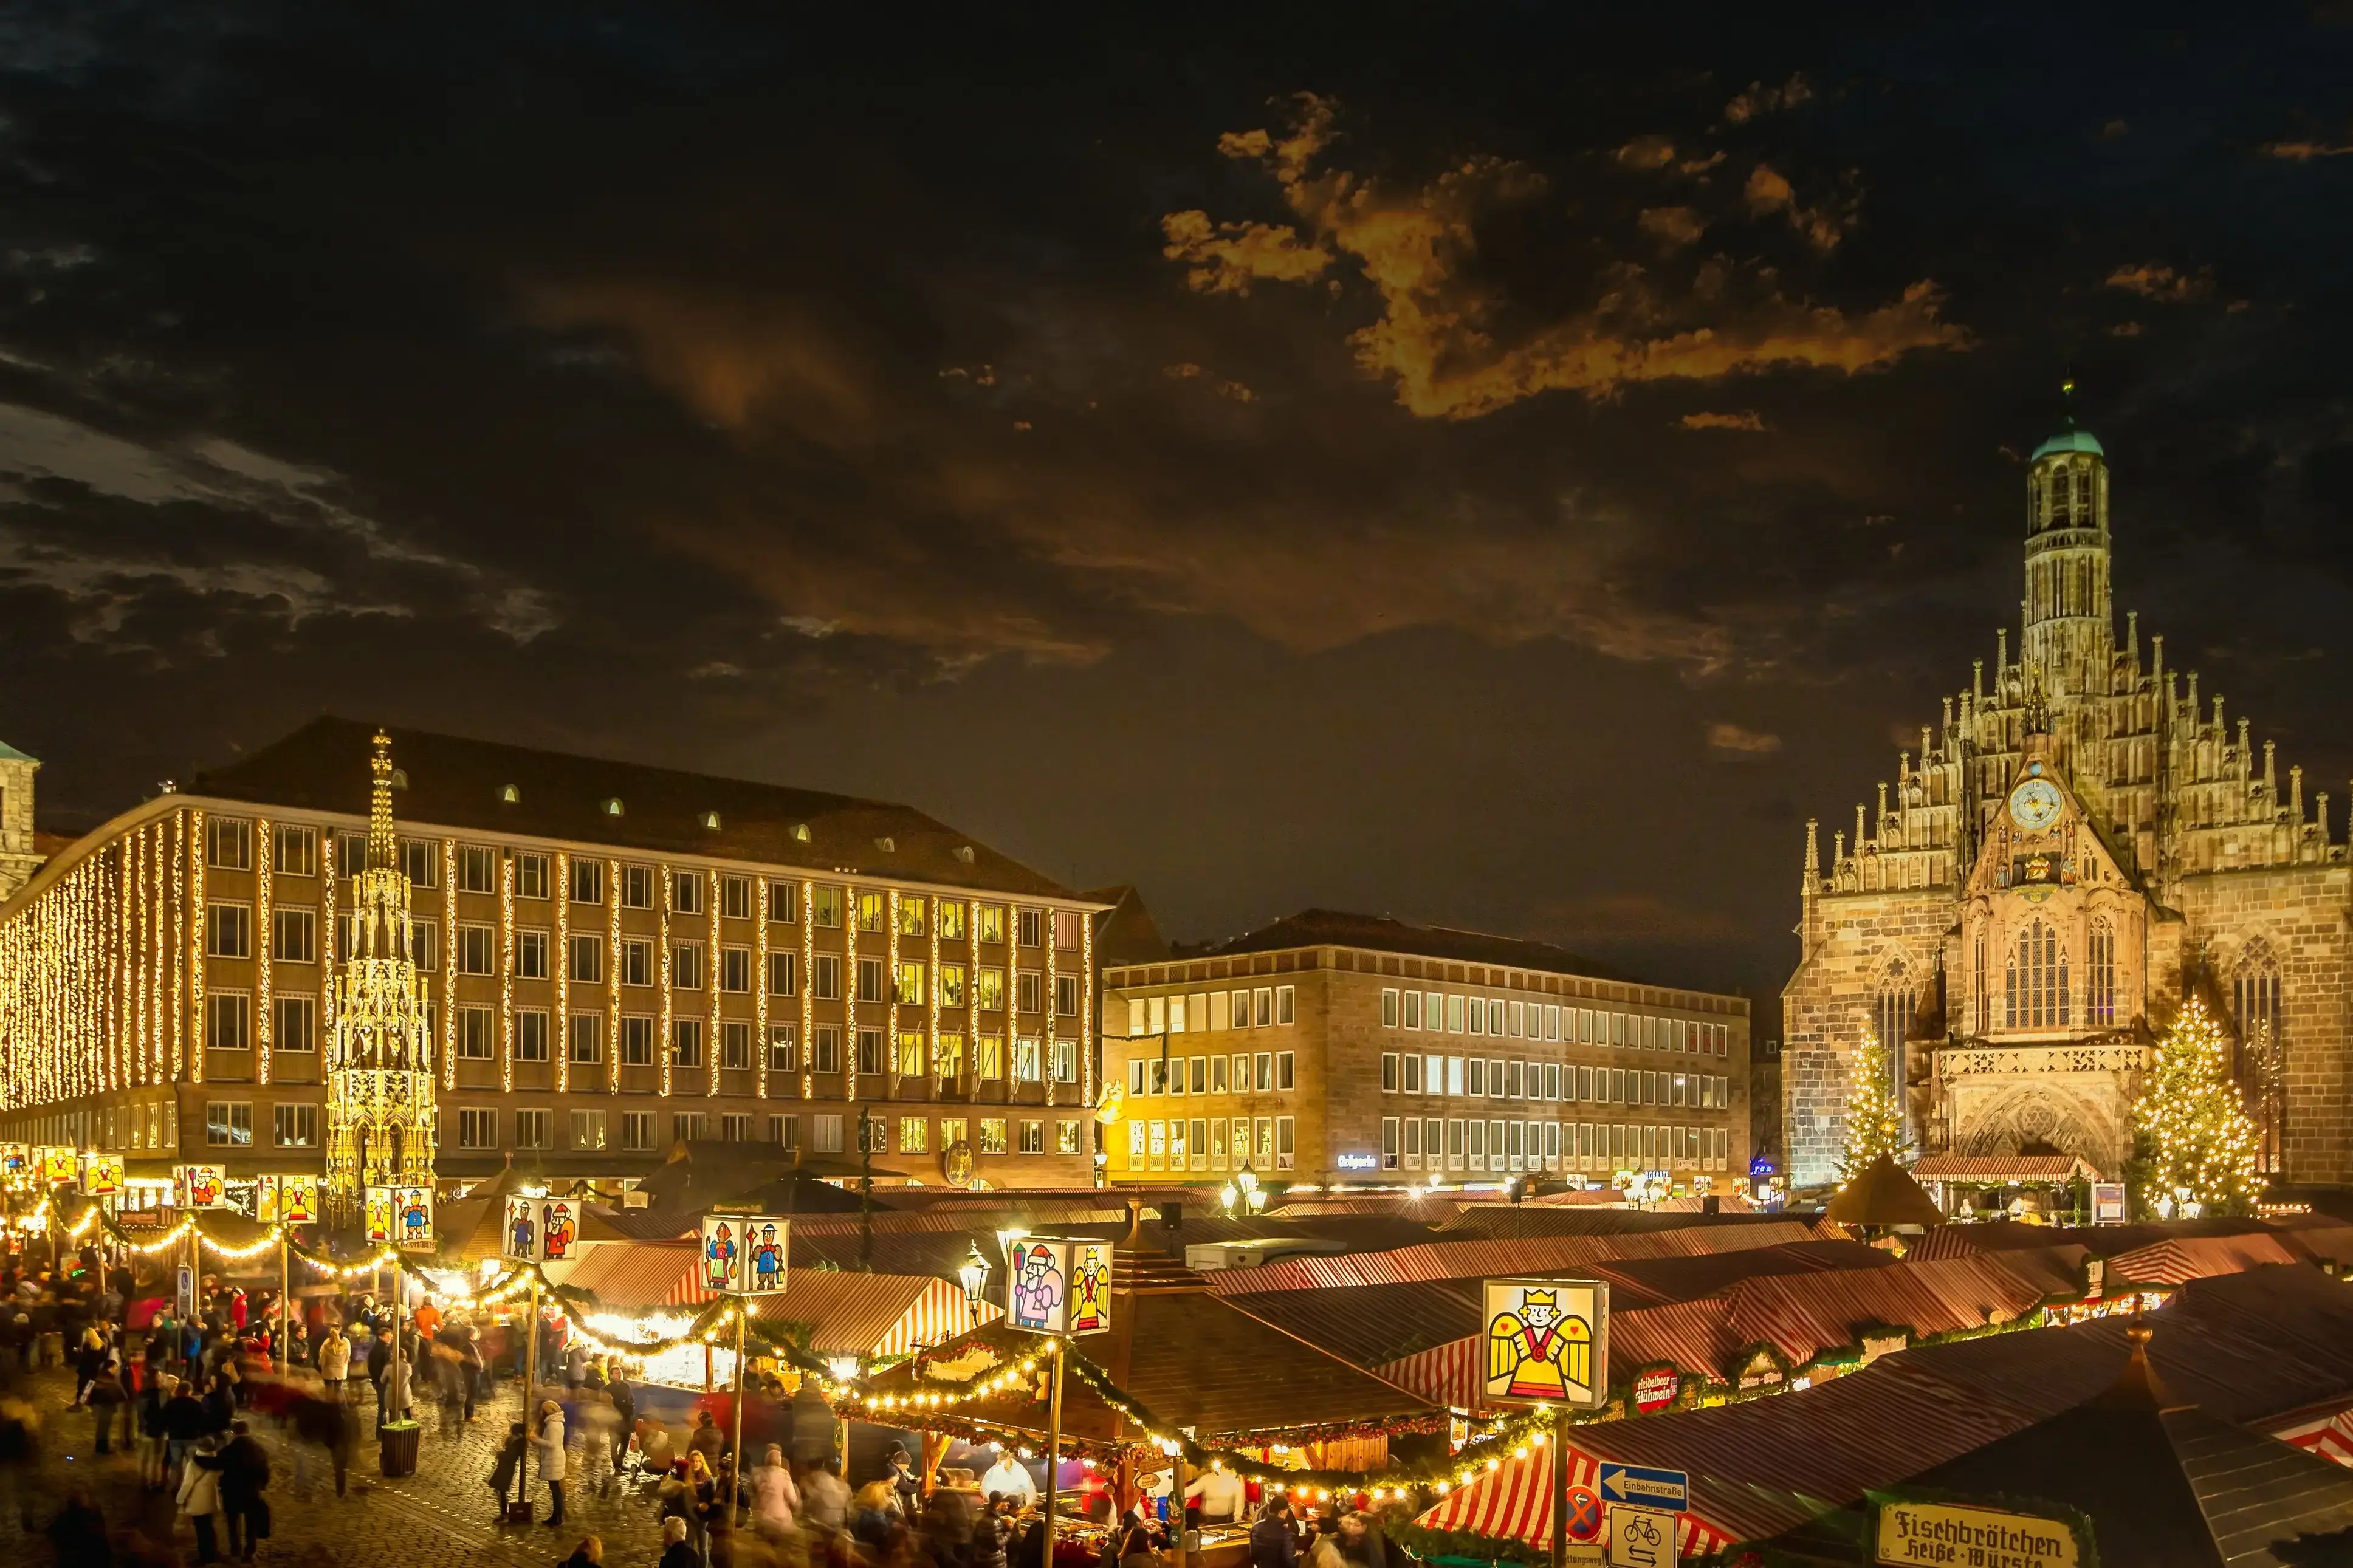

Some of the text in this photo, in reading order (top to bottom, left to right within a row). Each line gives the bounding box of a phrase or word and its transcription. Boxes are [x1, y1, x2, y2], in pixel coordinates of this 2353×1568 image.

[1638, 1375, 1670, 1390] Heidelbeer
[1635, 1386, 1670, 1403] Glühwein
[1624, 1480, 1682, 1496] Einbahnstraße
[1894, 1510, 2063, 1558] Fischbrötchen
[1565, 1555, 1601, 1566] ttungsweg
